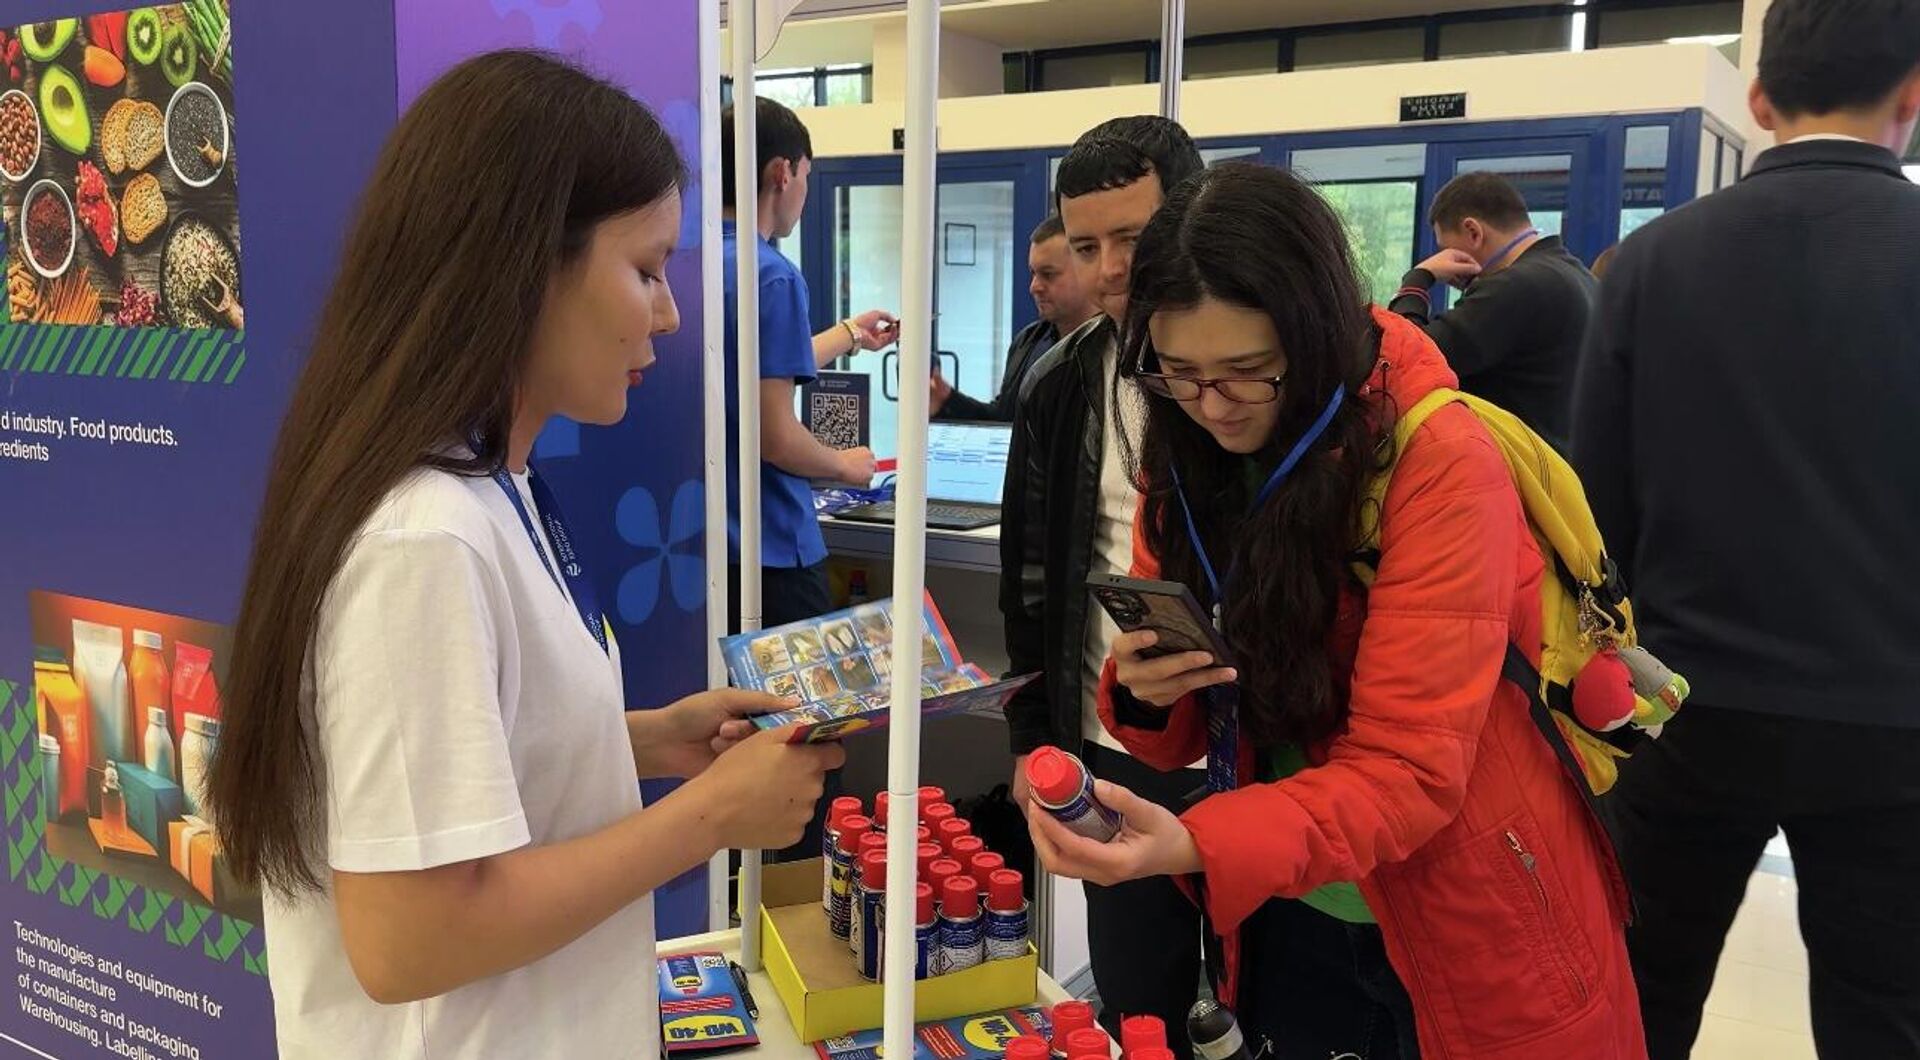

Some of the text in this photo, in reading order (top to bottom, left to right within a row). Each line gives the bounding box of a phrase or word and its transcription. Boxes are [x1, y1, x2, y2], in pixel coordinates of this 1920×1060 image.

[12, 411, 67, 439] industry.
[70, 416, 106, 439] Food
[110, 422, 178, 446] products.
[13, 920, 223, 1019] Technologies and equipment for
[16, 946, 117, 1002] the manufacture
[17, 973, 200, 1060] of containers and packaging
[19, 994, 103, 1048] Warehousing.
